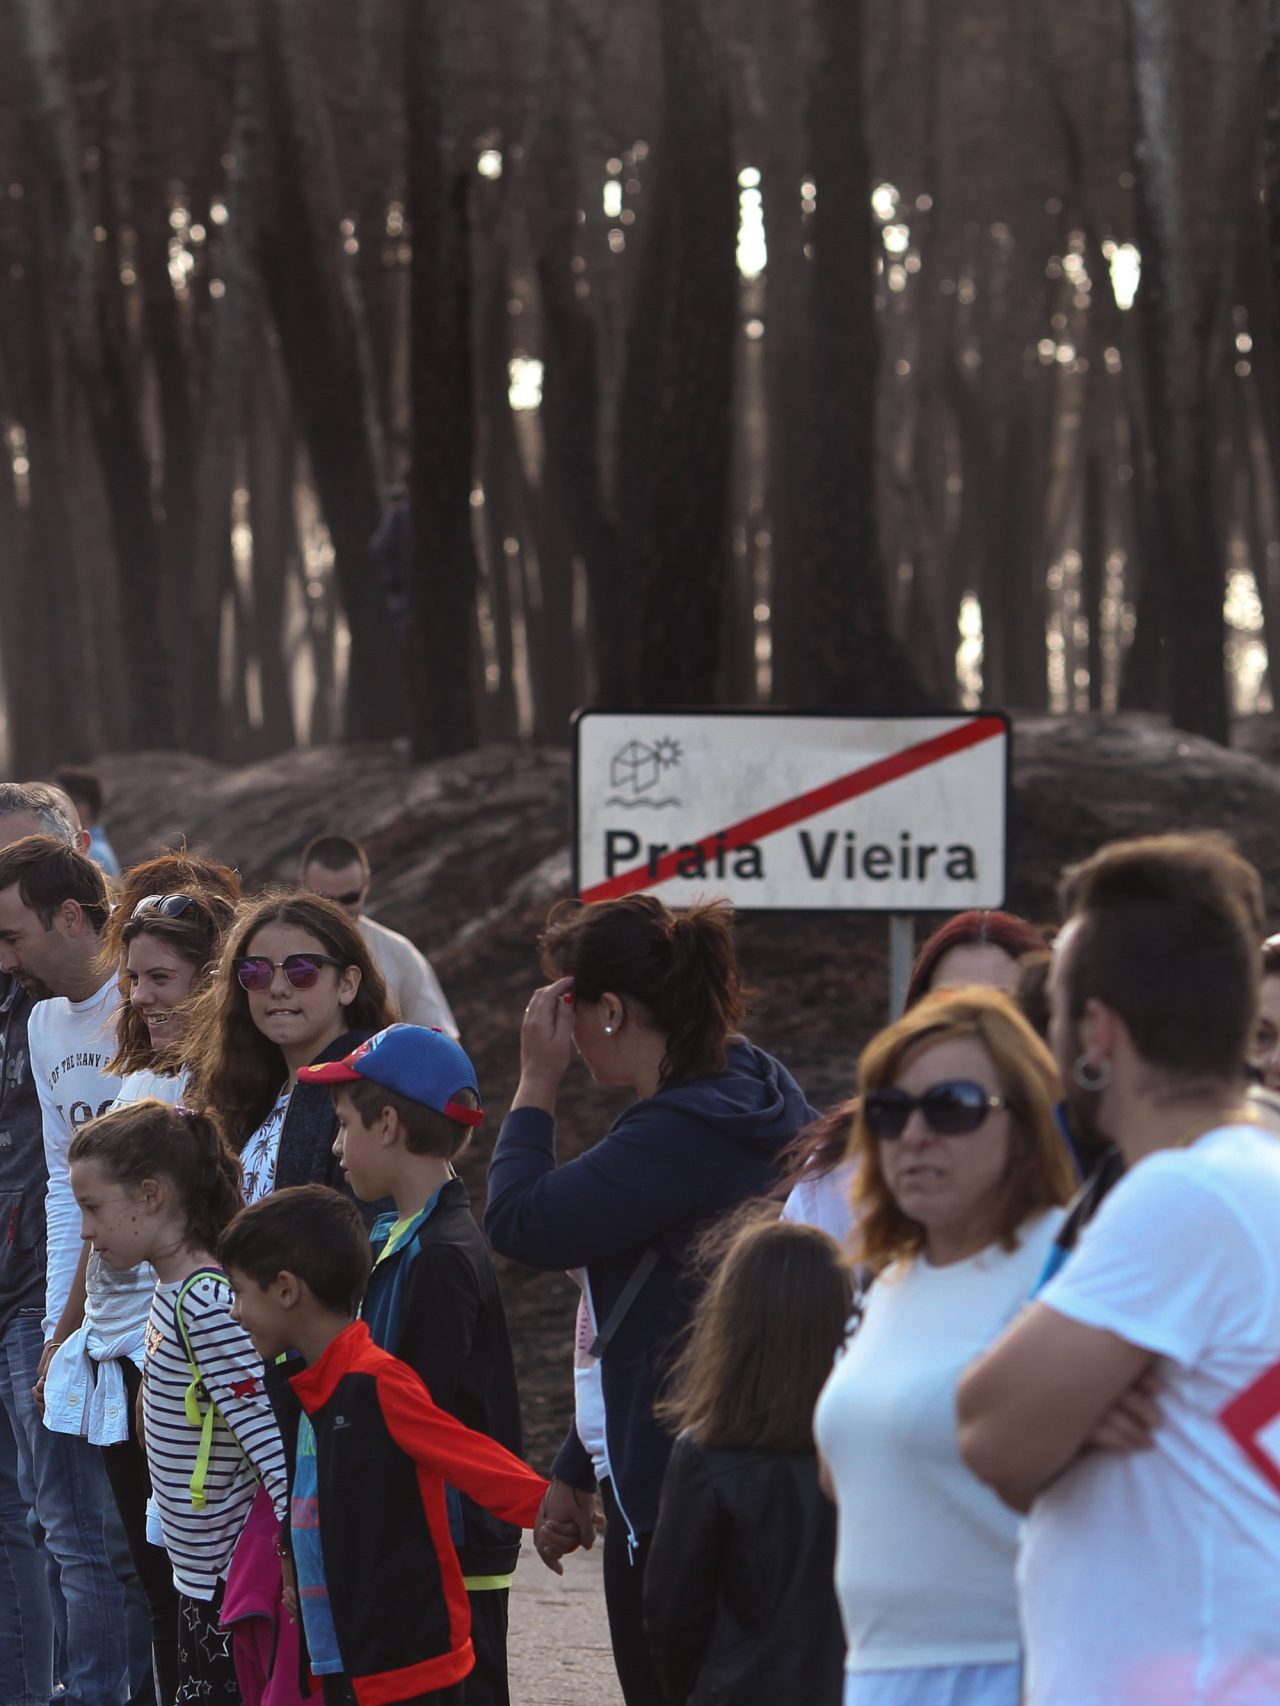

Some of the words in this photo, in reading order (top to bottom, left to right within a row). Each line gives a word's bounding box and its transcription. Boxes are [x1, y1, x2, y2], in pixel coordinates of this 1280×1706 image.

[603, 829, 765, 880] Praia
[800, 830, 977, 881] Vieira
[61, 1055, 75, 1073] THE
